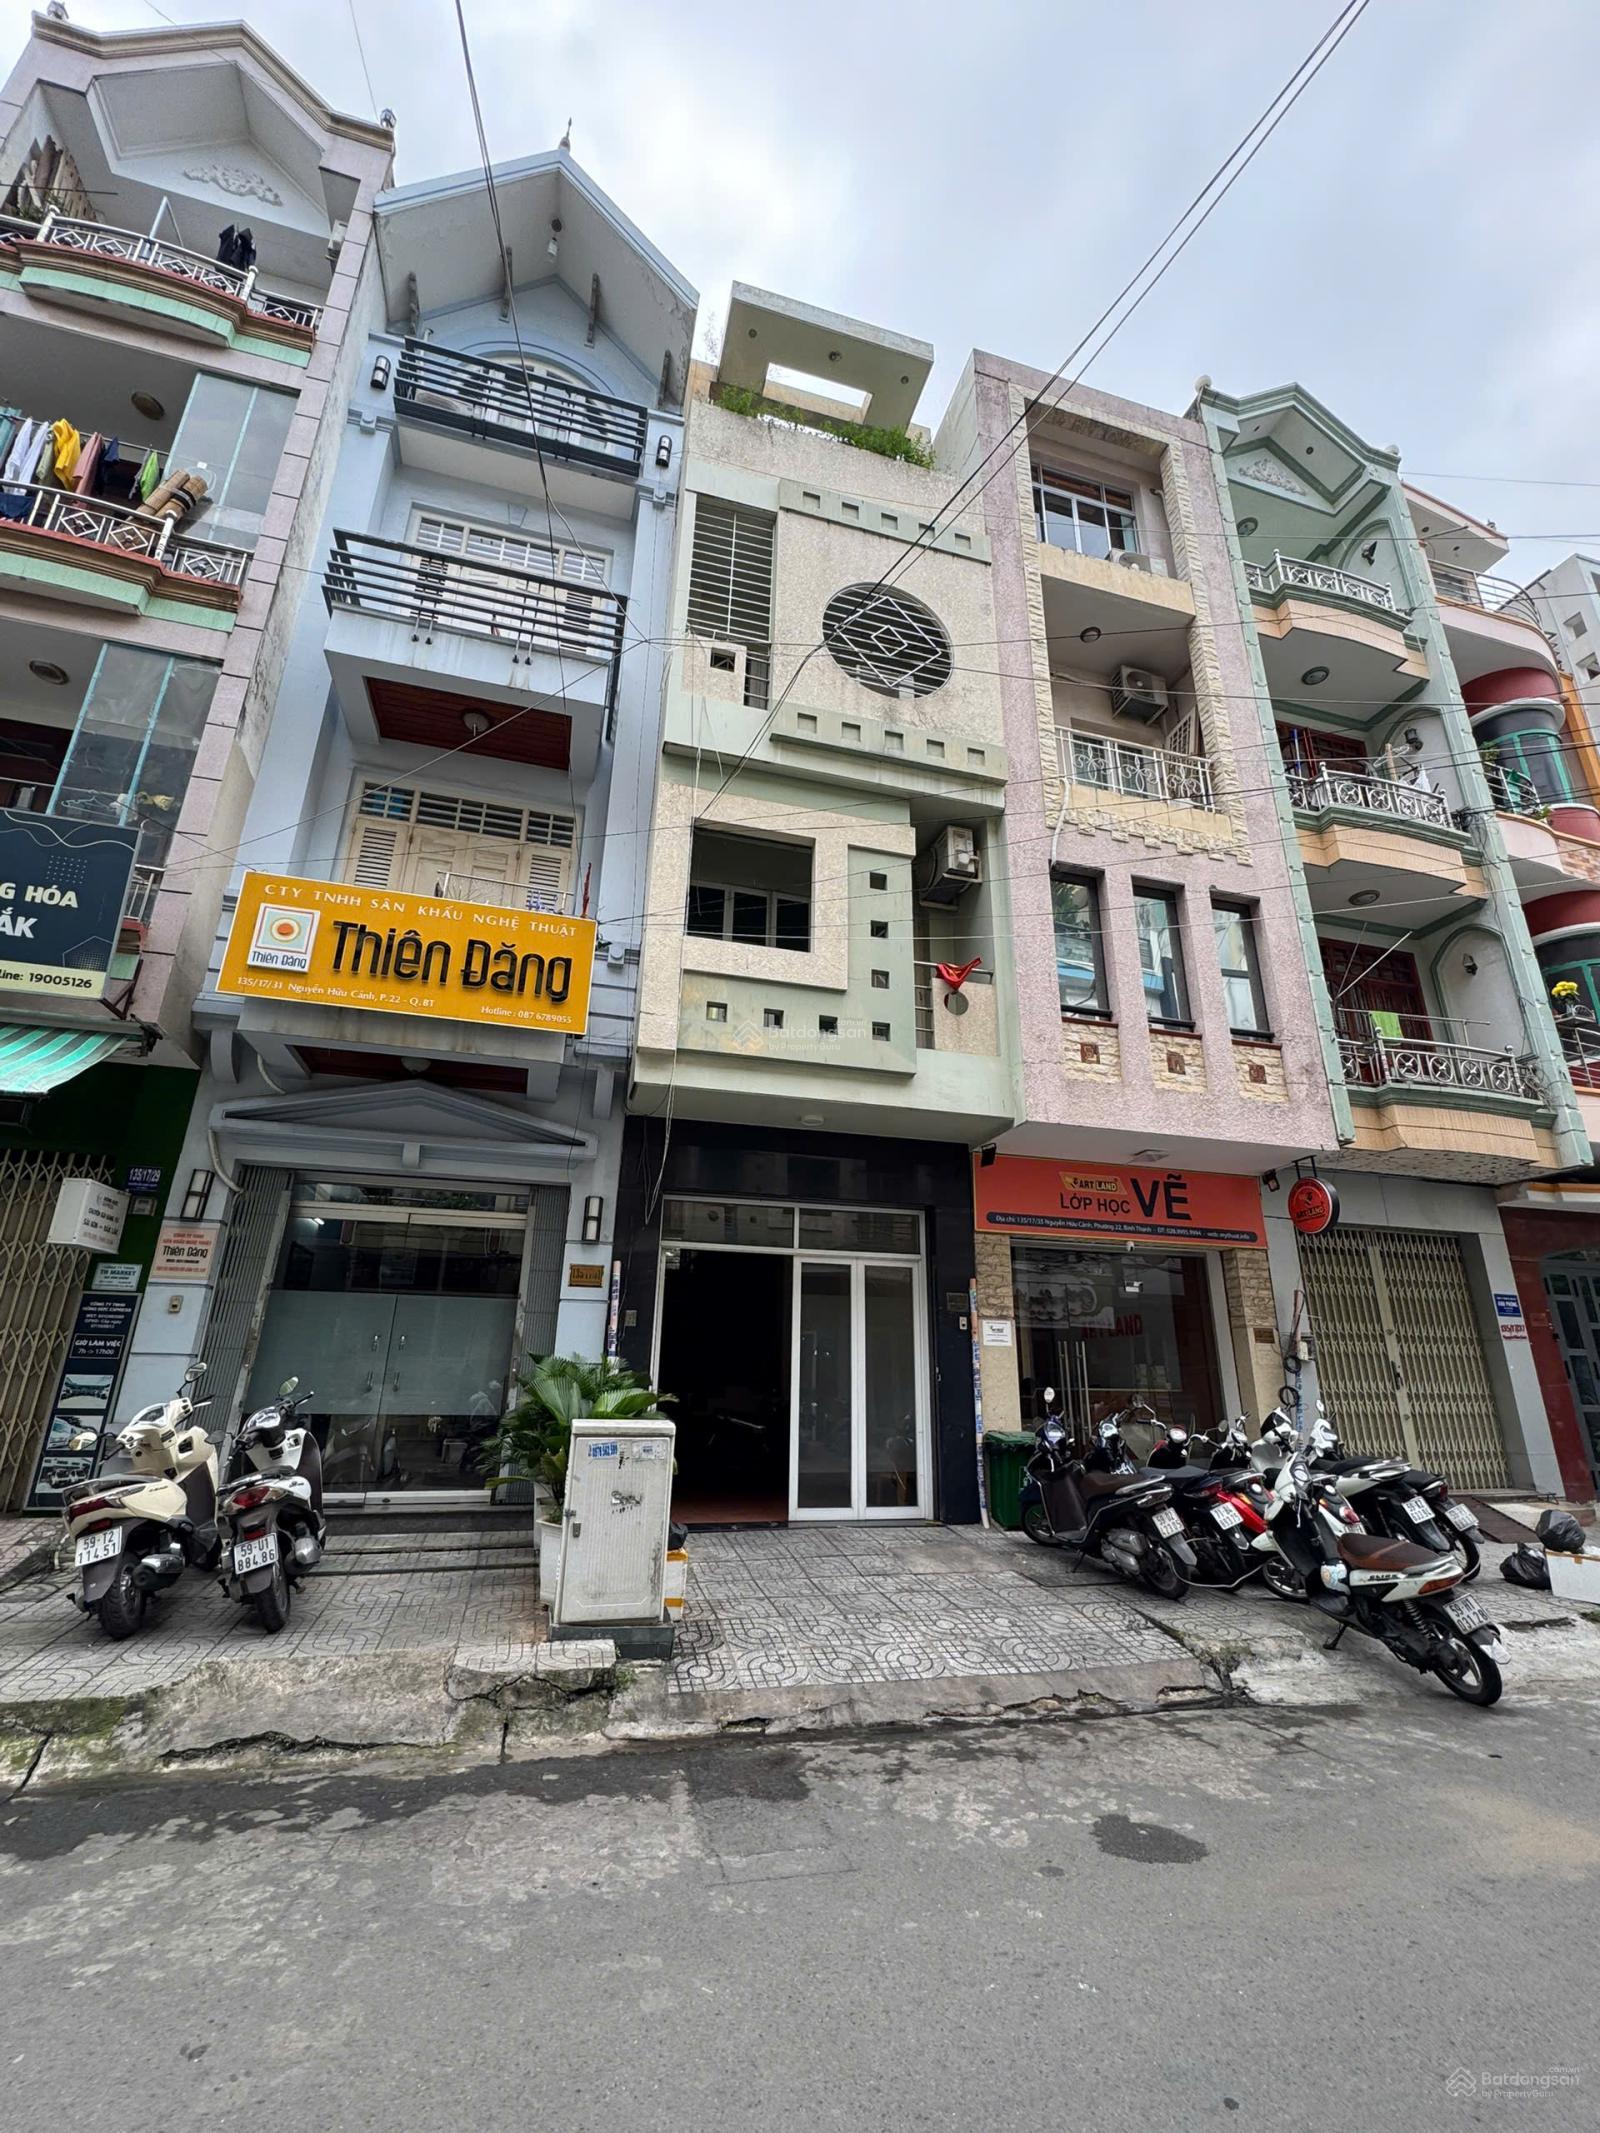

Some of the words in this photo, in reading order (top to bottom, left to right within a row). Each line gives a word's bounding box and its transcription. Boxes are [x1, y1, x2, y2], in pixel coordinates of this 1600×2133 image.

[25, 885, 78, 908] HÓA
[264, 884, 303, 898] CTY
[314, 891, 361, 906] TNHH
[370, 898, 406, 913] SÂN
[418, 905, 463, 921] KHẤU
[473, 913, 520, 929] NGHỆ
[530, 921, 577, 937] THUẬT
[252, 951, 278, 965] Thiên
[333, 920, 452, 985] Thiên
[460, 938, 572, 1003] Đăng
[29, 972, 92, 988] 19005126
[237, 976, 282, 989] 135/17/31
[288, 983, 324, 995] Nguyễn
[130, 1168, 160, 1182] 135/17/29
[1060, 1192, 1092, 1210] LỚP
[1097, 1198, 1131, 1216] HỌC
[1130, 1173, 1192, 1220] VẼ
[163, 1246, 185, 1257] Thiên
[84, 1530, 114, 1550] 59-T2
[241, 1537, 269, 1557] 59-U1
[78, 1542, 116, 1564] 114.51
[237, 1549, 275, 1571] 884.86
